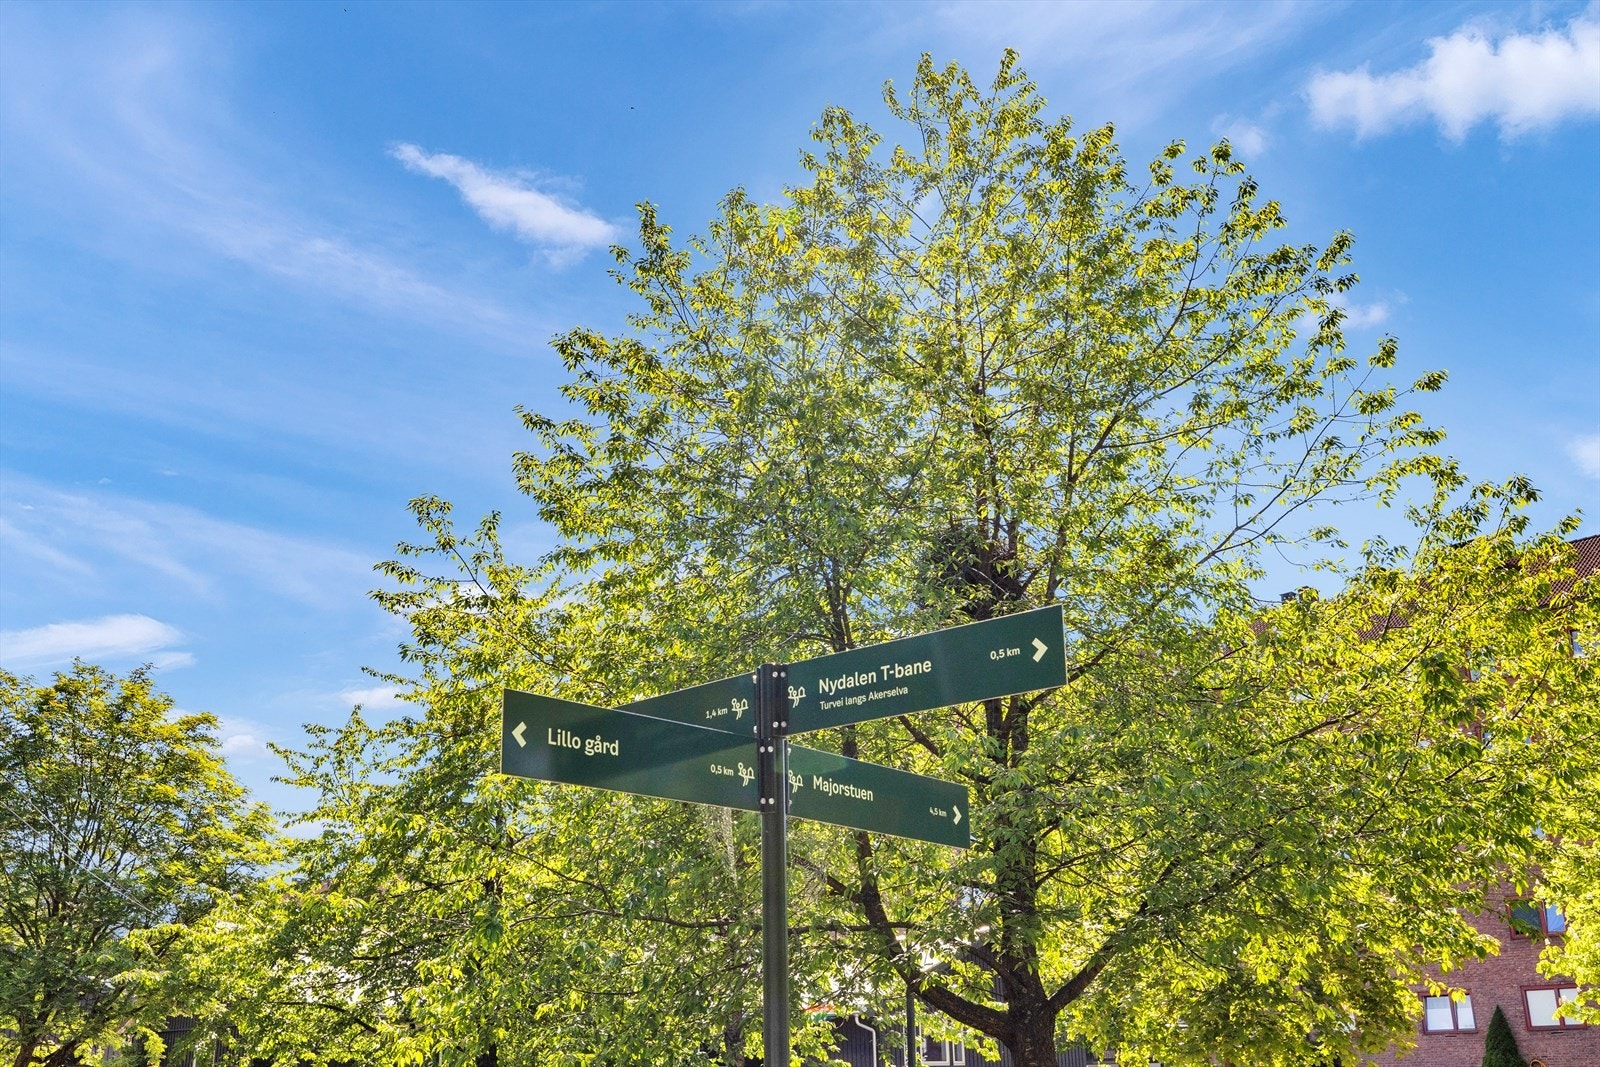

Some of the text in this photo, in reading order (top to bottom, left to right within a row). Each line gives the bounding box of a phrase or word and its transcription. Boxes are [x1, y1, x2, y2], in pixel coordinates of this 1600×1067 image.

[990, 647, 1021, 660] 0,5 km
[819, 660, 932, 695] Nydalen T-bane
[819, 686, 908, 710] Turvei langs Akerselva
[705, 707, 728, 719] 1,4 km
[547, 727, 619, 756] Lillo gård
[710, 764, 734, 776] 0,5 km
[813, 775, 874, 802] Majorstuen
[929, 806, 947, 817] 4,5 km
